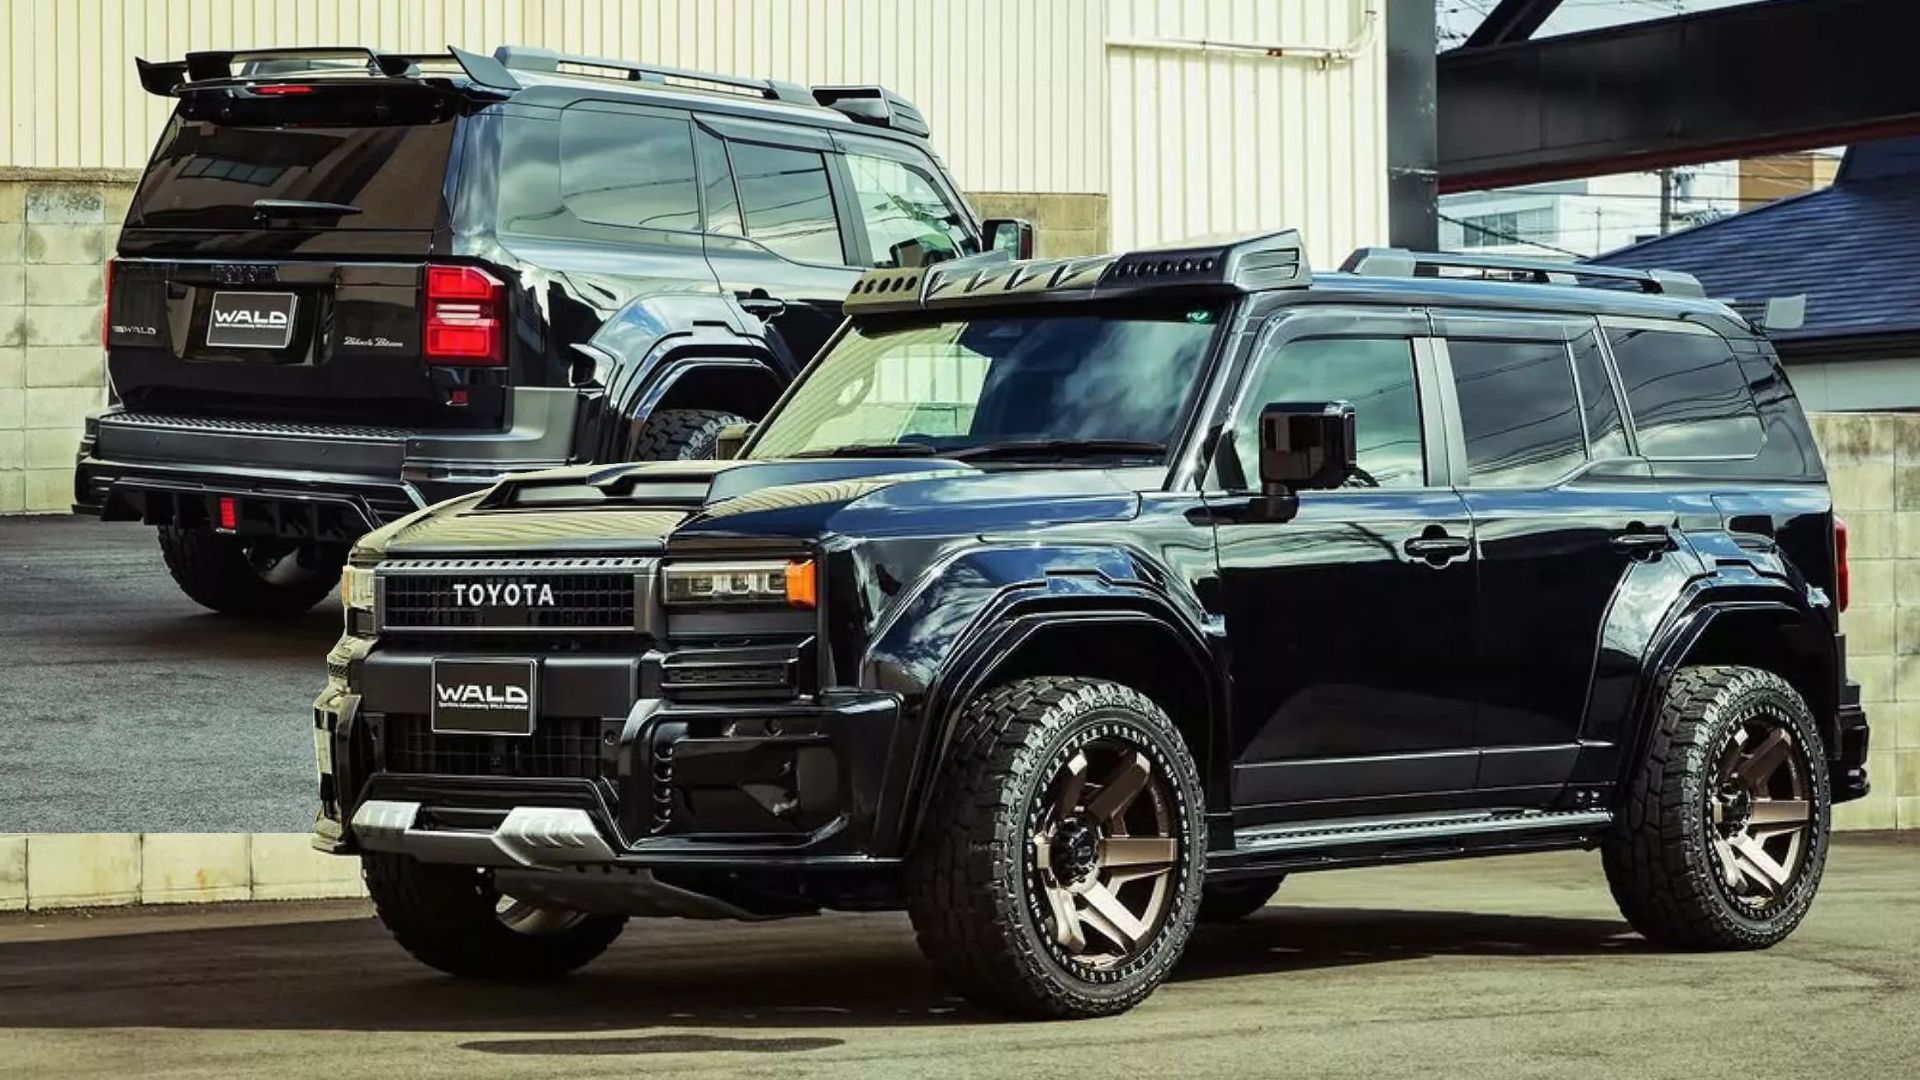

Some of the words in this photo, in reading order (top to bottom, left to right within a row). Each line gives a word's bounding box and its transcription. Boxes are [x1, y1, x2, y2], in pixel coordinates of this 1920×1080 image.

[215, 309, 288, 324] WALD
[123, 326, 157, 335] WALD
[453, 583, 555, 606] TOYOTA
[436, 683, 528, 703] WALD
